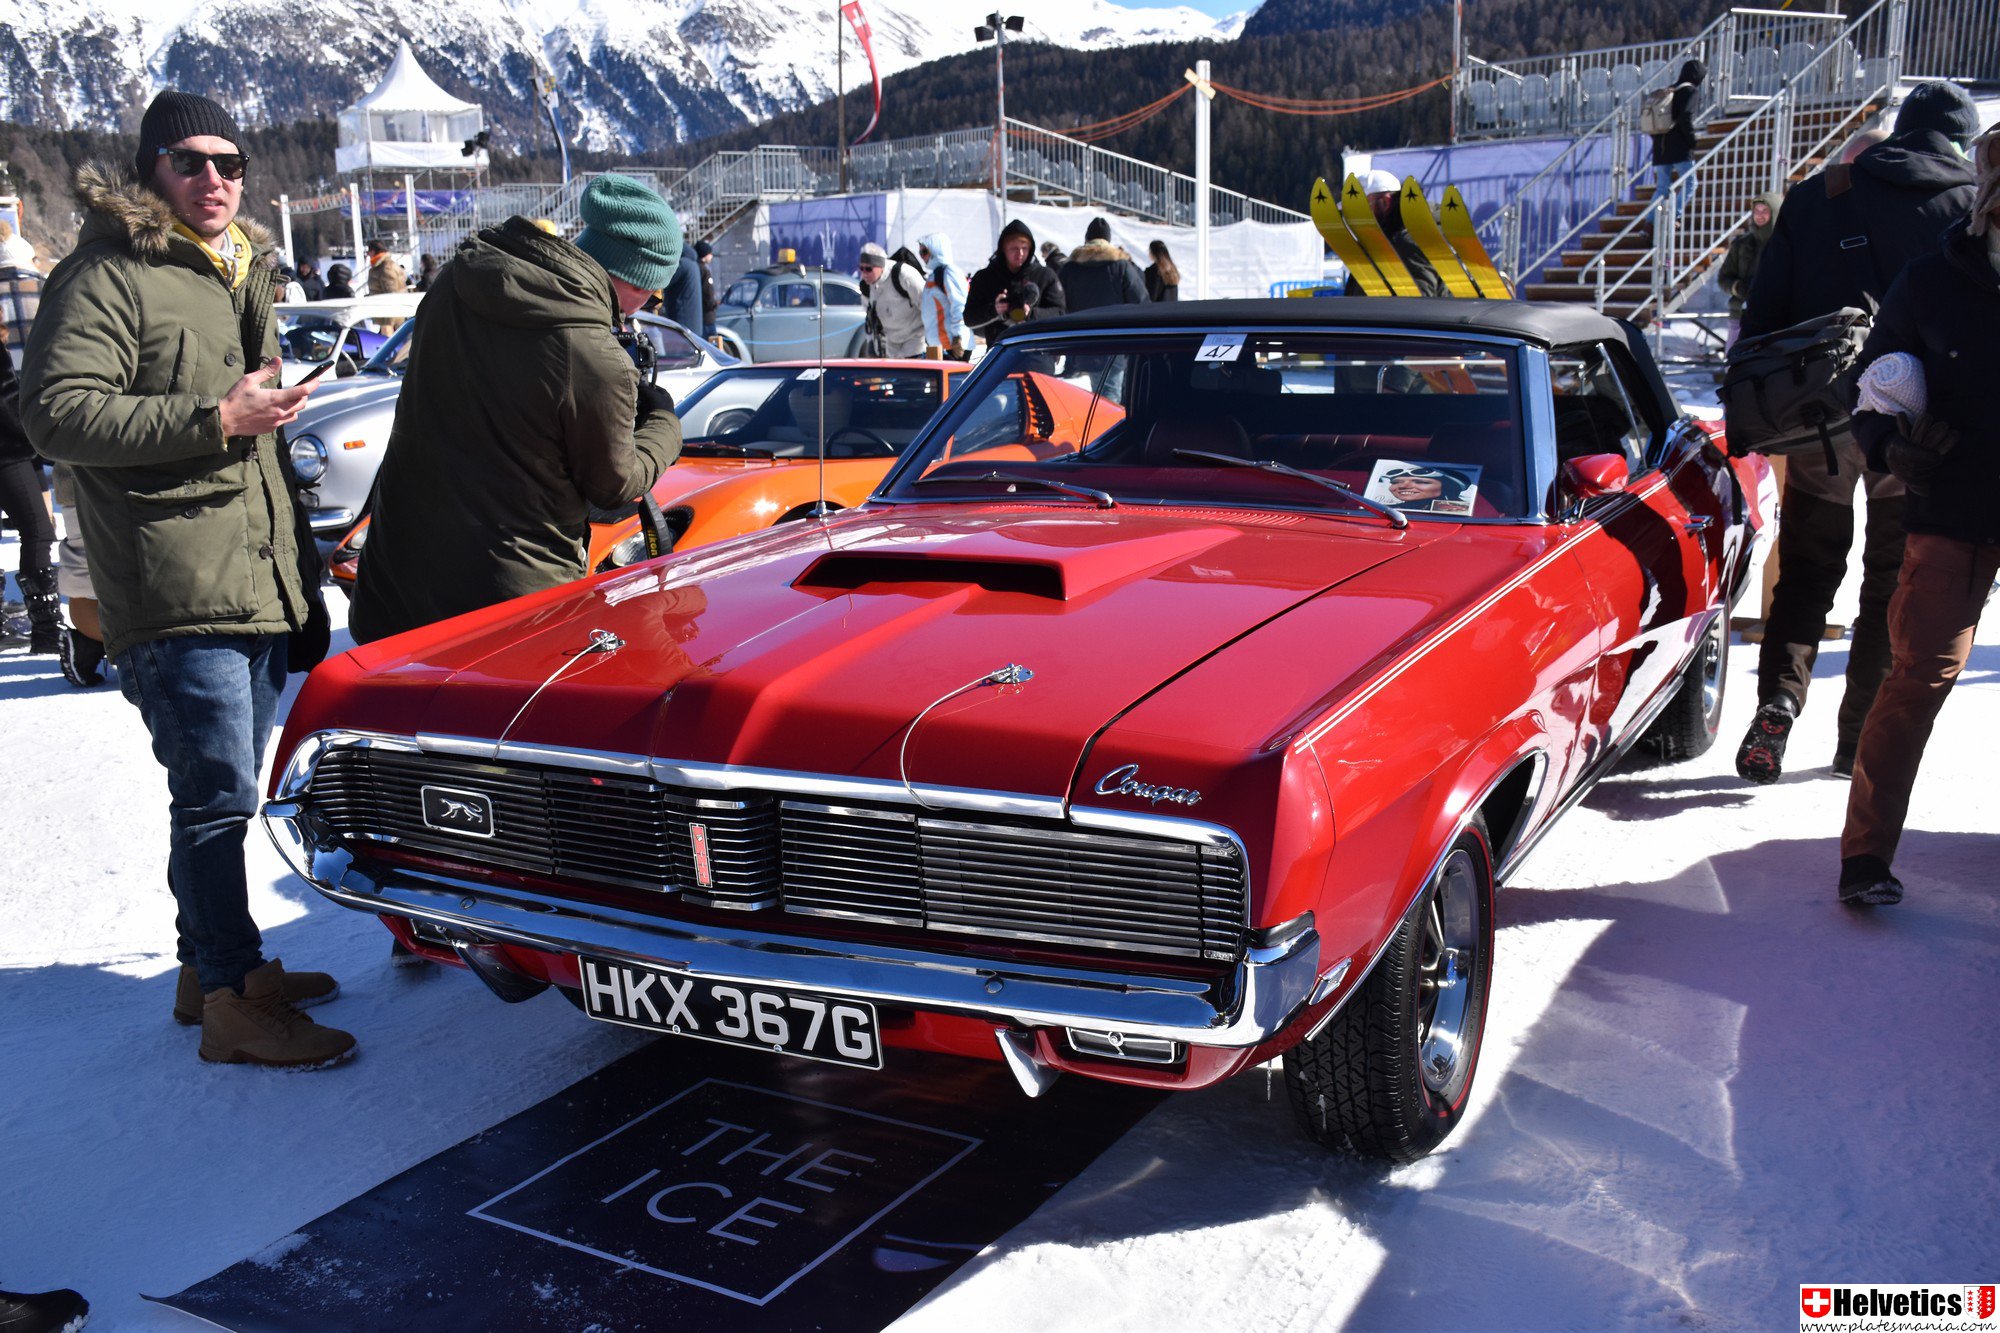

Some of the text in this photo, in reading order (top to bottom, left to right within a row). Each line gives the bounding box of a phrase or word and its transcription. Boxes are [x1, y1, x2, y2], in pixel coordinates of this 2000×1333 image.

[1204, 344, 1236, 358] 47
[1094, 763, 1203, 807] Cougar
[585, 961, 873, 1060] HKX 367G
[680, 1117, 877, 1194] THE
[600, 1168, 806, 1246] ICE
